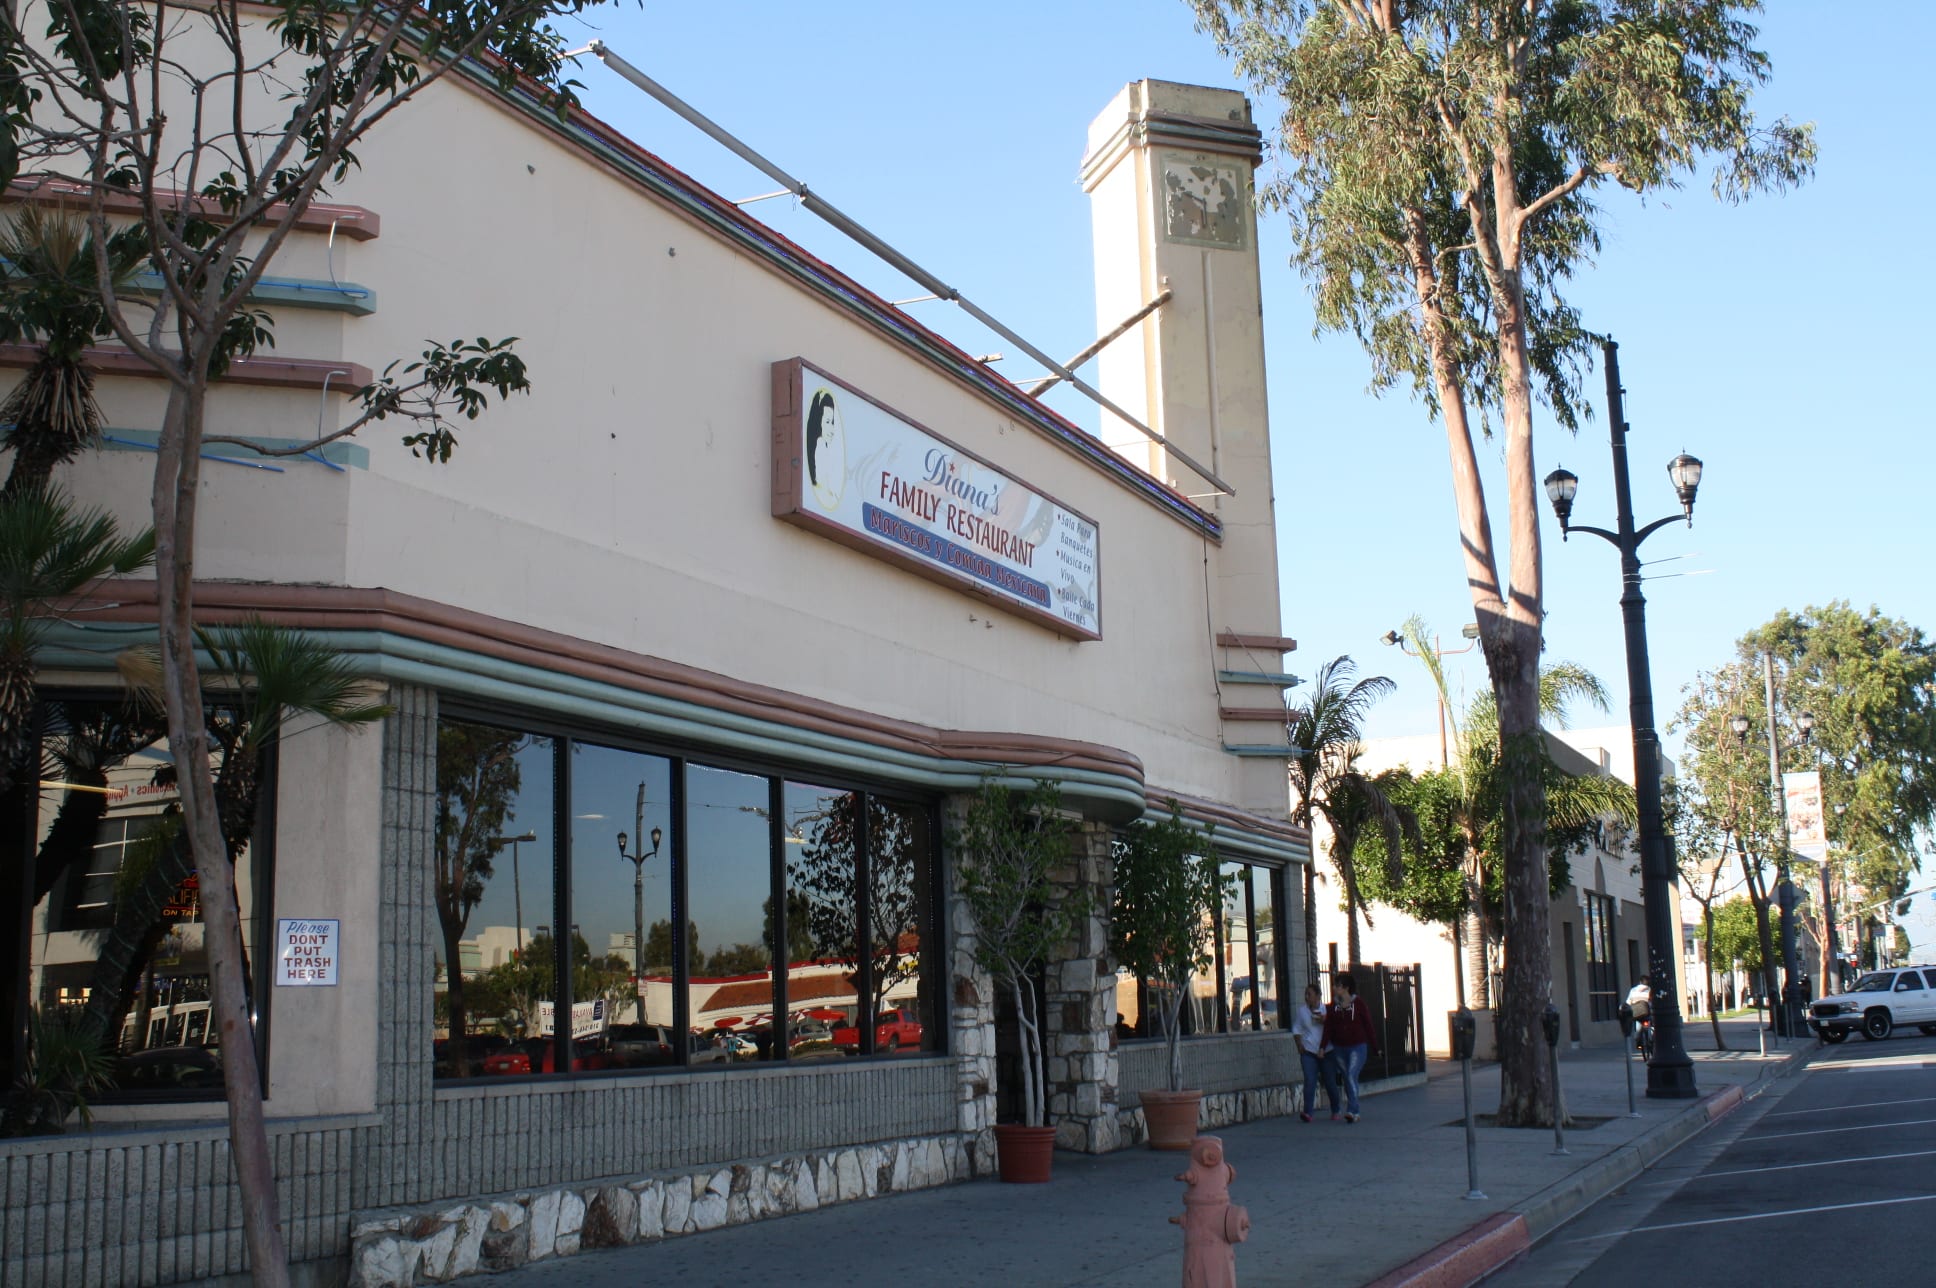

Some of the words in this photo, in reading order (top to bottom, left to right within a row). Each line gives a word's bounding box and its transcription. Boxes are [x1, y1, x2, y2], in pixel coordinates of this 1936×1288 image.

[922, 448, 1000, 516] Diana's
[880, 471, 942, 522] FAMILY
[946, 503, 1036, 569] RESTAURANT
[1061, 514, 1075, 531] Sala
[1060, 531, 1093, 559] Banquetes
[870, 507, 931, 552] Mariscos
[934, 541, 943, 560] y
[947, 542, 992, 580] Comida
[995, 565, 1047, 603] Mexicana
[1060, 567, 1075, 585] Vivo
[1061, 588, 1078, 605] Baile
[1062, 605, 1087, 625] Viernes
[286, 921, 330, 934] Please
[289, 934, 329, 945] DONT
[294, 946, 322, 956] PUT
[283, 957, 332, 968] TRASH
[287, 969, 326, 979] HERE
